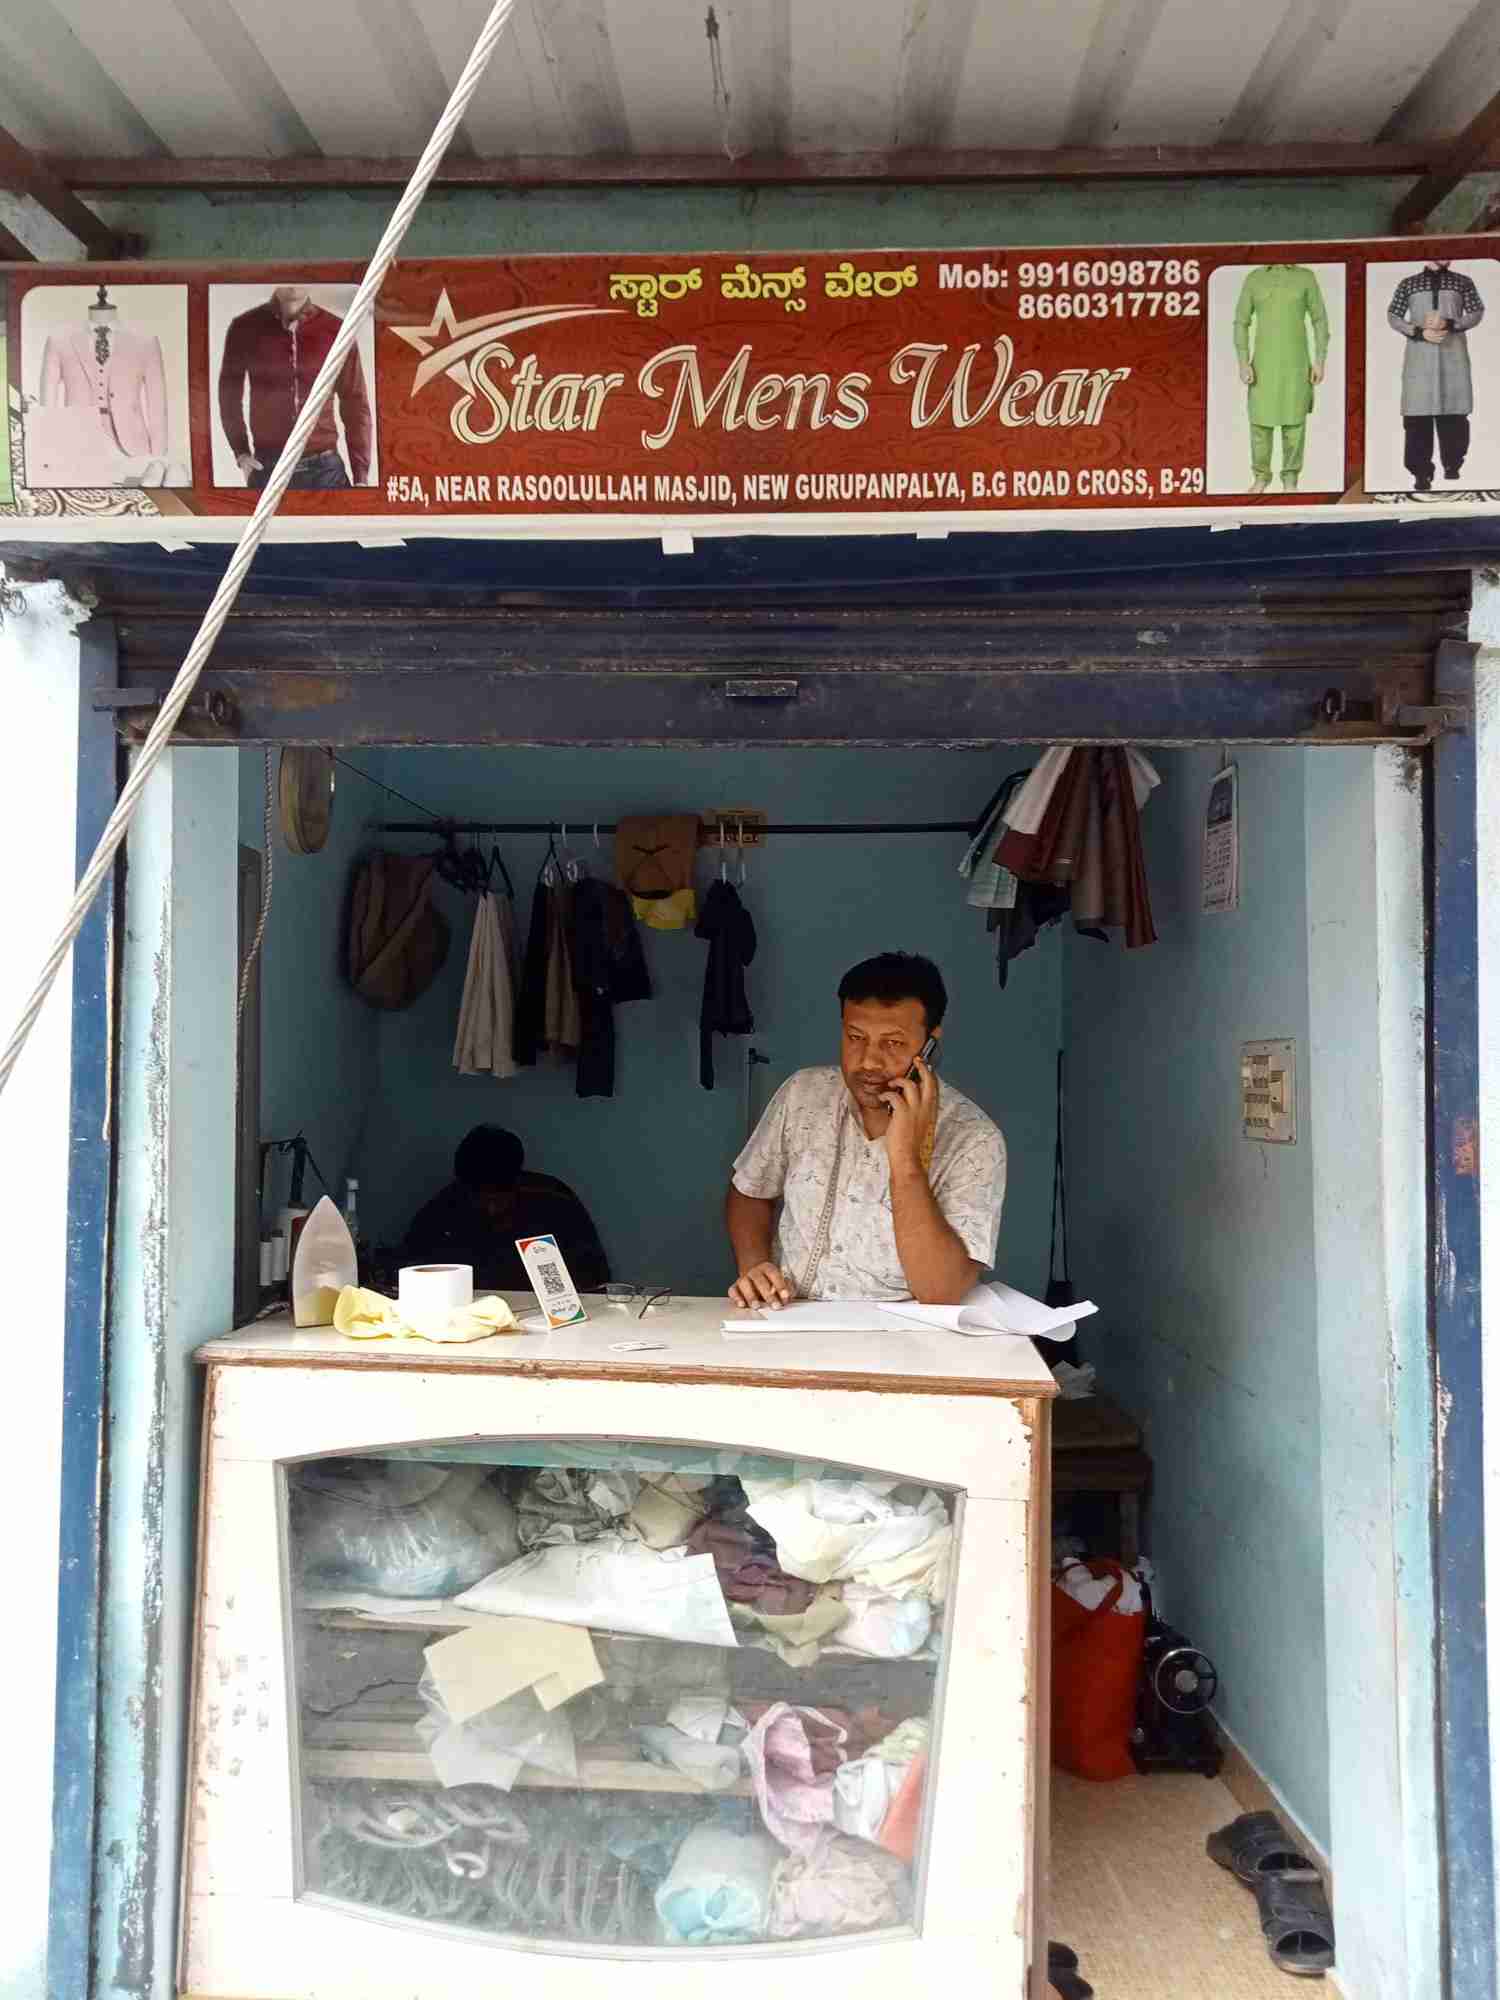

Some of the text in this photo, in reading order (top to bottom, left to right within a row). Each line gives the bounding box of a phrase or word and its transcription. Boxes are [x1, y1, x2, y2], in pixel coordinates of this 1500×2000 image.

[609, 262, 918, 317] ಸ್ಟಾರ್ ಮೆನ್ಸ್ ವೇರ್
[938, 259, 1201, 290] Mob: 9916098786
[1018, 291, 1201, 319] 8660317782
[450, 333, 1132, 451] Star Mens Wear
[386, 467, 1204, 507] #5A, NEAR RASOOLULLAH MASJID, NEW GURUPANPALYA, B.G ROAD CROSS, B-29
